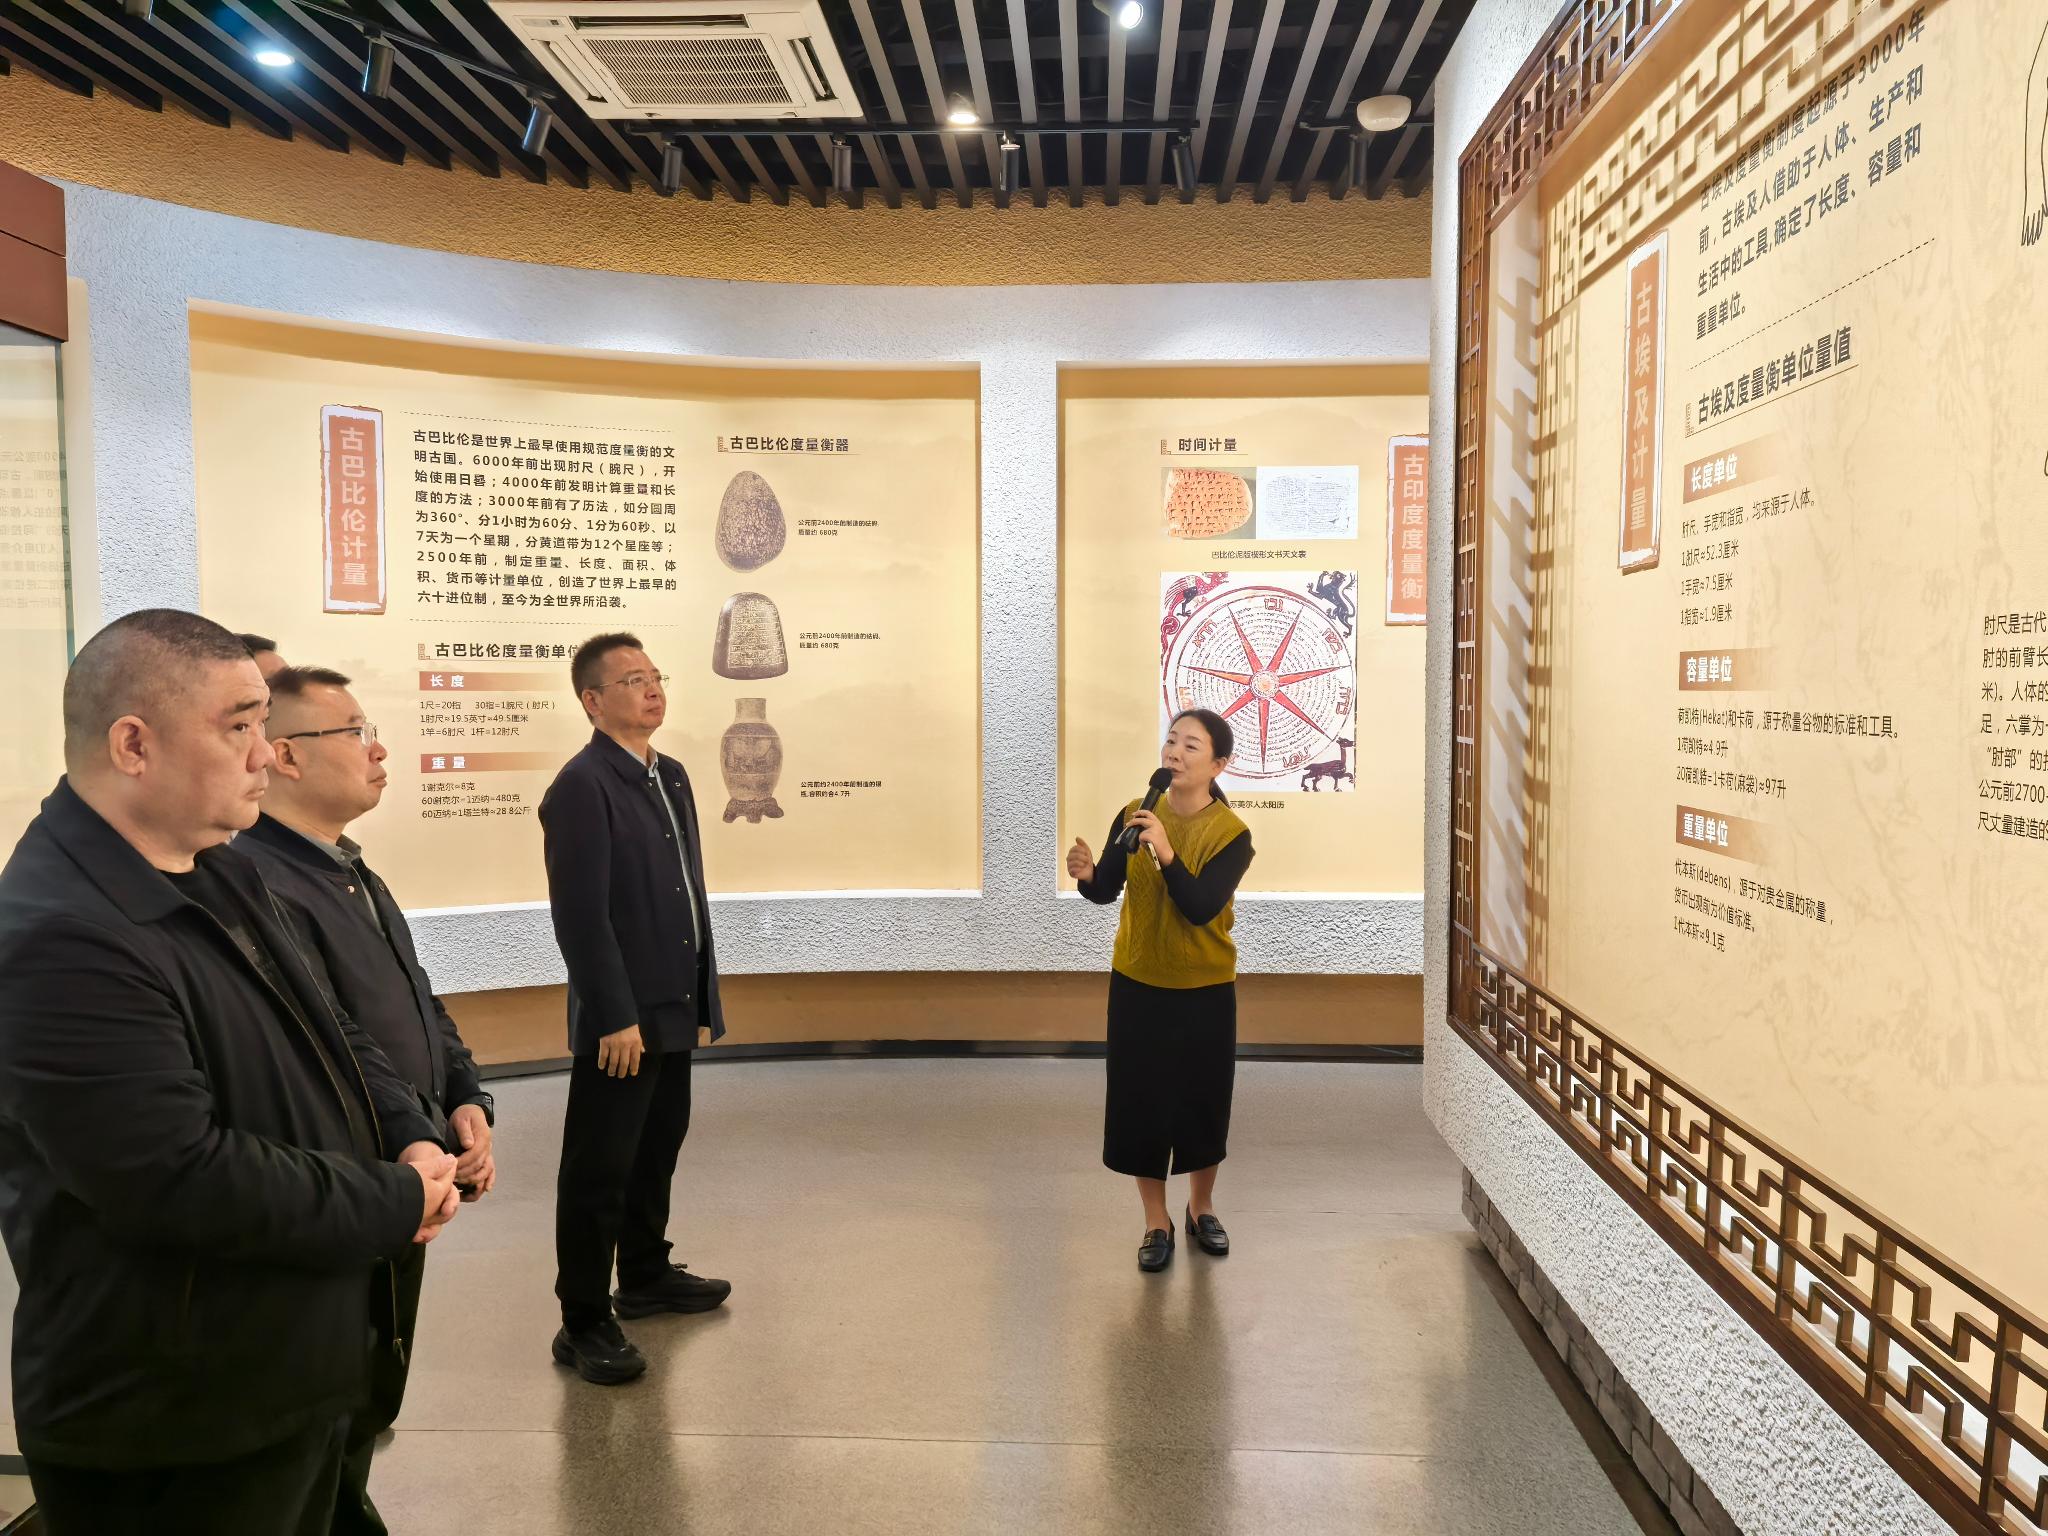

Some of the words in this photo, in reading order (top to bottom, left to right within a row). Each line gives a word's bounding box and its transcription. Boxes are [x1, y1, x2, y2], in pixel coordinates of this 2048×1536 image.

[1700, 6, 1925, 212] 古埃及度量衡制度起源于3000年
[1699, 64, 1924, 255] 前，古埃及人借助于人体、生产和
[1696, 291, 1746, 340] 重量单位。
[1699, 326, 1851, 425] 古埃及度量衡单位量值
[1630, 282, 1653, 530] 古埃及计量
[413, 429, 675, 458] 古巴比伦是世界上最早使用规范度量衡的文
[730, 436, 849, 452] 古巴比伦度量衡器
[1178, 438, 1237, 451] 时间计量
[1691, 453, 1738, 492] 长度单位
[340, 427, 368, 586] 古巴比伦计量
[1401, 454, 1425, 599] 古印度度量衡
[417, 570, 677, 591] 积、货币等计量单位，创造了世界上最早的
[418, 590, 629, 608] 六十进位制，至今为全世界所沿袭。
[1984, 611, 2047, 635] 肘尺是古代
[430, 674, 464, 688] 长度
[1686, 656, 1732, 683] 容量单位
[1981, 713, 2048, 736] 足，六掌为
[432, 756, 465, 769] 重量
[1979, 779, 2048, 803] 公元前2700
[1683, 813, 1729, 847] 重量单位
